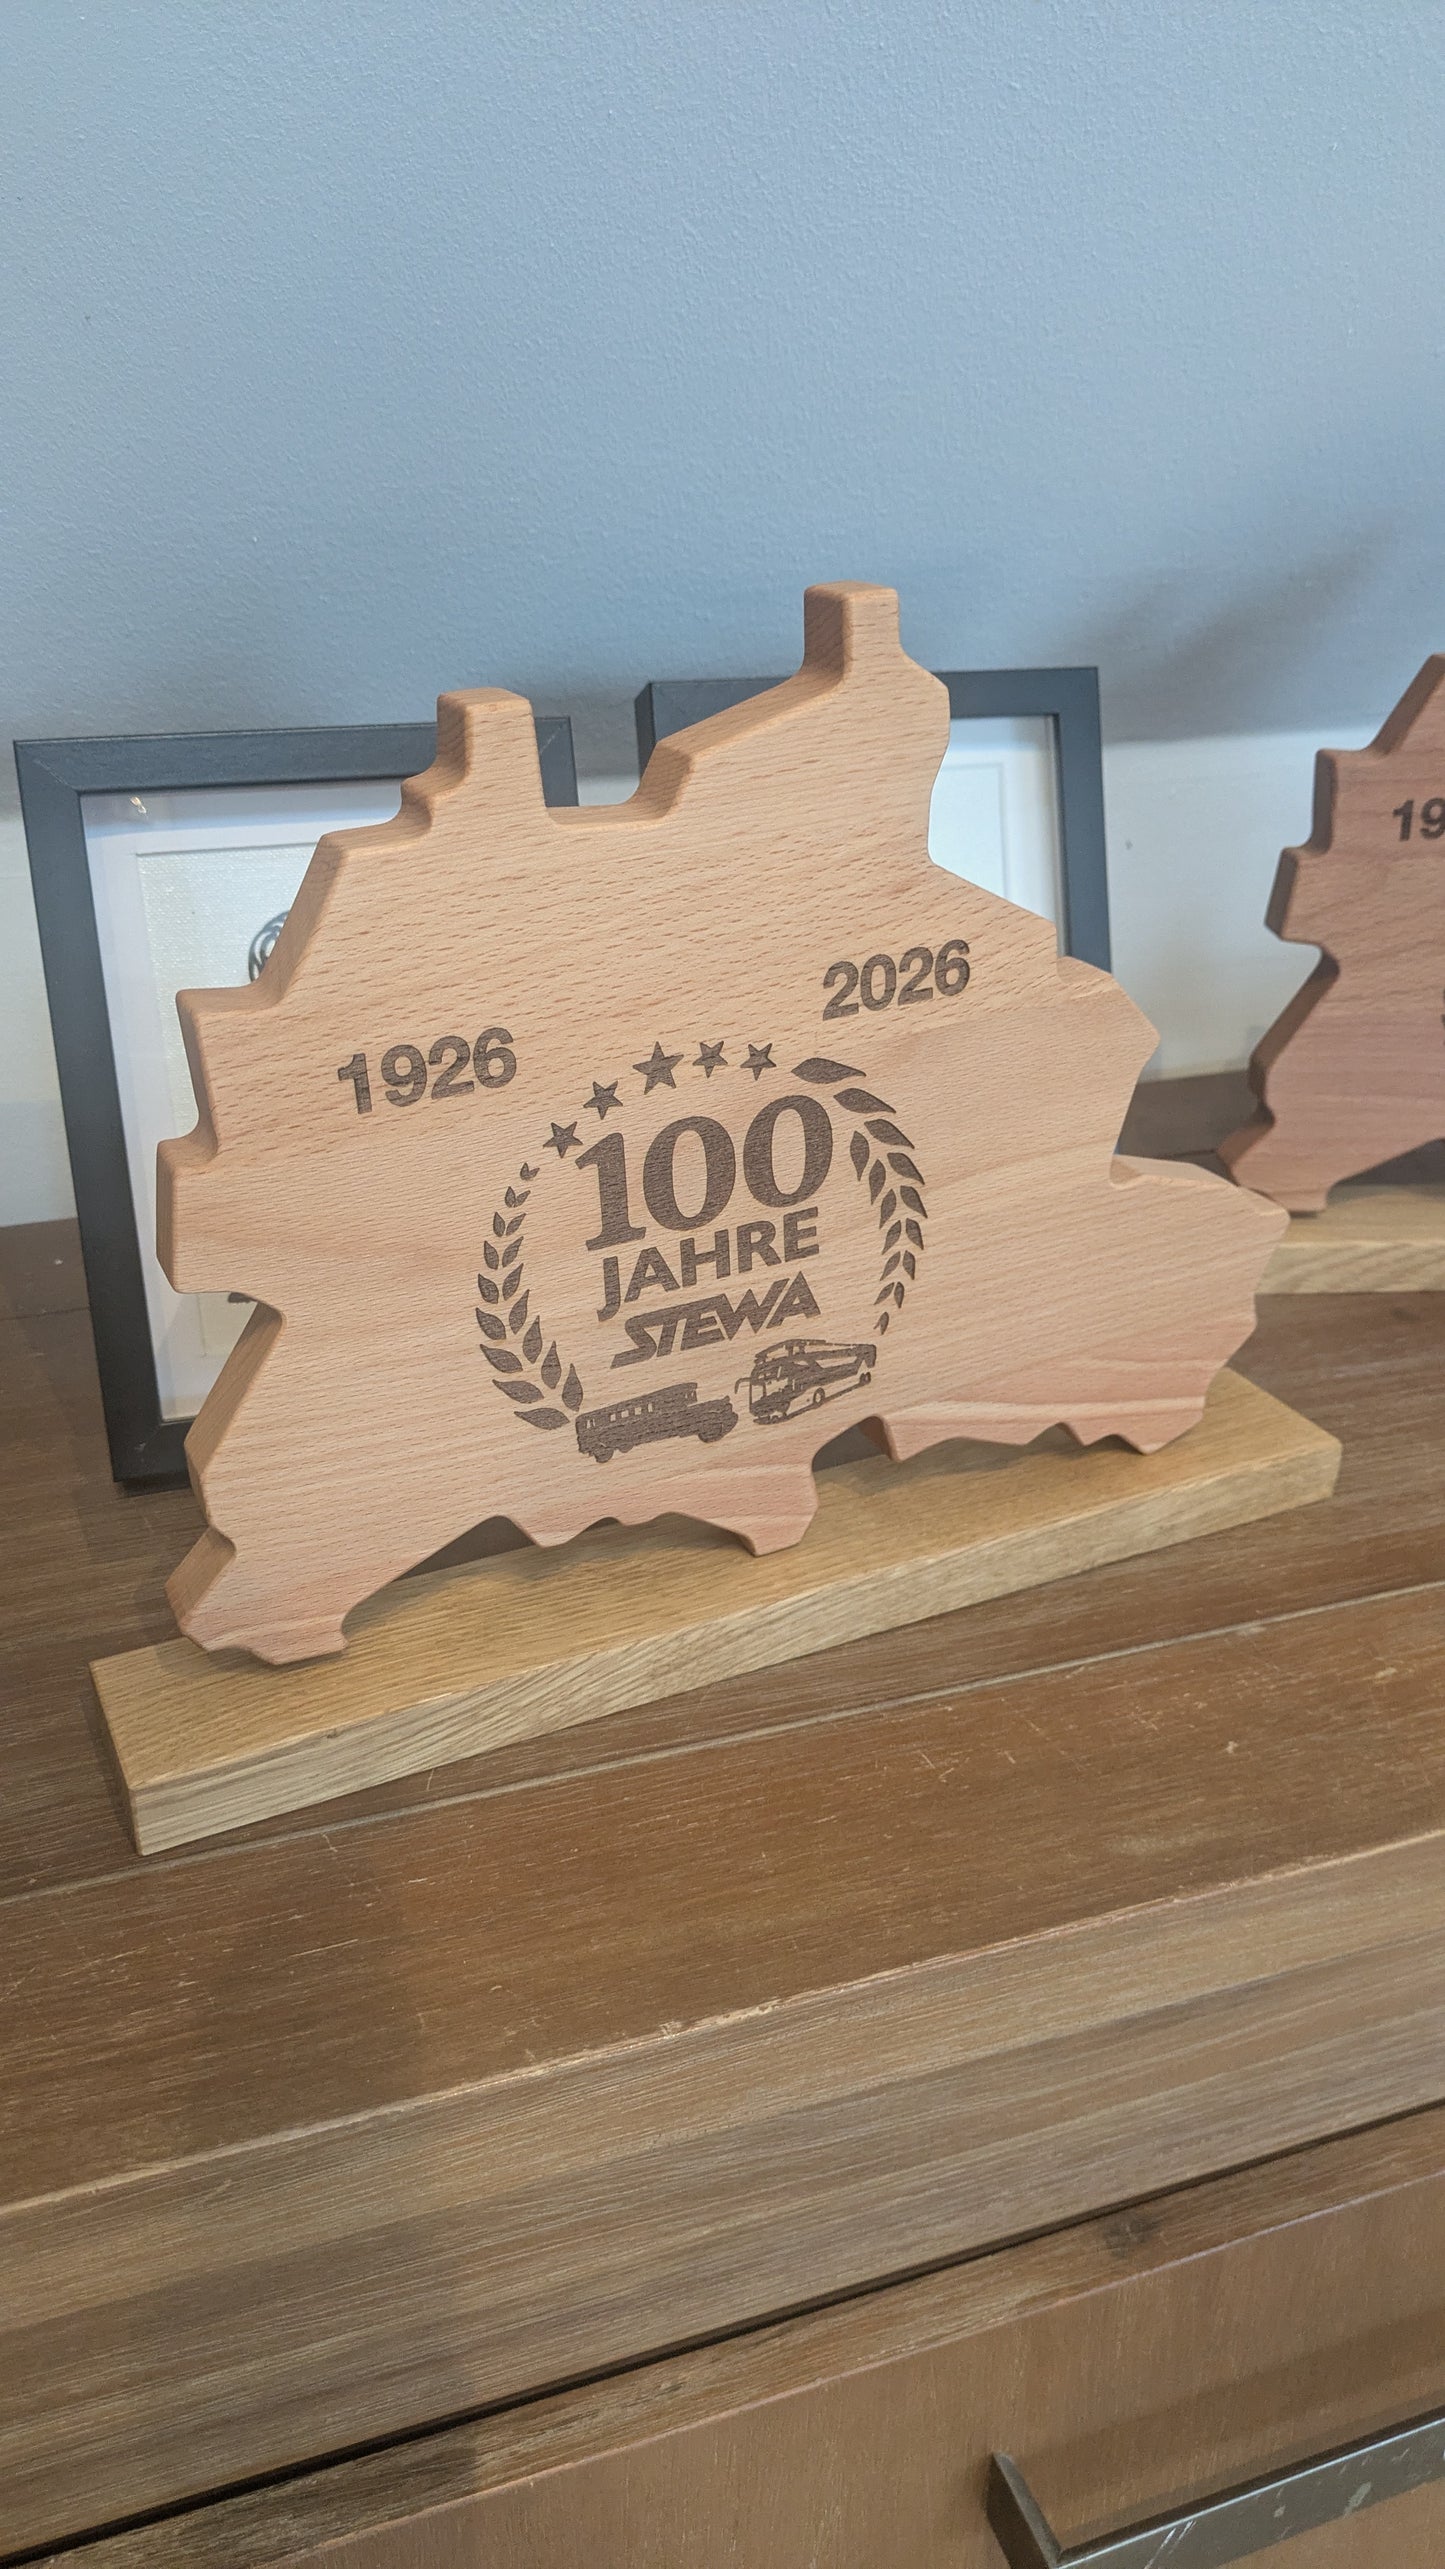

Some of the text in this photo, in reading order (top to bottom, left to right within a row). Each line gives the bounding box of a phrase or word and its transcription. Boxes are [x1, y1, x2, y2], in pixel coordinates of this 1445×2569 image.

[823, 939, 971, 1021] 2026
[337, 1027, 518, 1115] 1926
[574, 1094, 834, 1252] 100
[596, 1206, 820, 1323] JAHRE
[609, 1270, 822, 1370] STEWA
